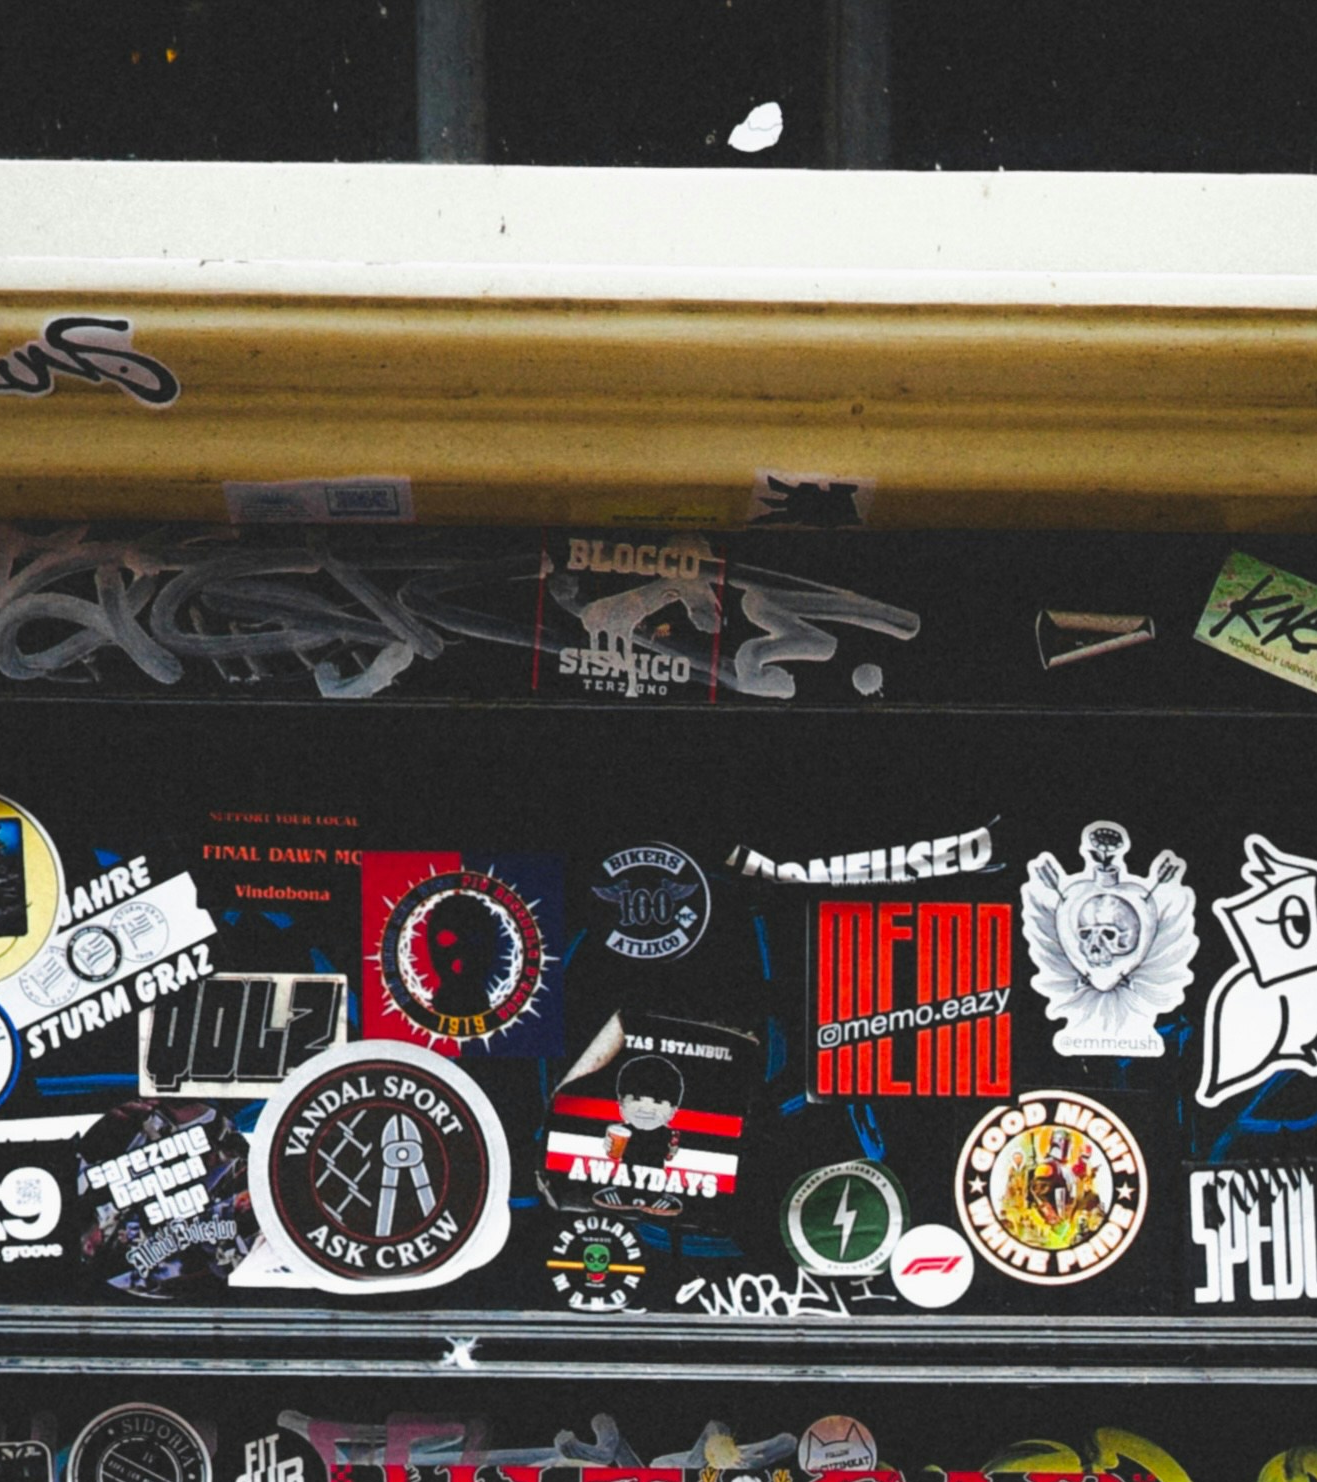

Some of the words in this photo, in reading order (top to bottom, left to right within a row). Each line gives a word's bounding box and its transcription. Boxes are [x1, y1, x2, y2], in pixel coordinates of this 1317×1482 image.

[567, 538, 700, 579] BLOCCO
[202, 844, 261, 865] FINAL
[267, 845, 328, 865] DAWN
[333, 847, 362, 865] MC
[605, 849, 686, 876] BIKERS
[234, 884, 330, 901] Vindobona
[24, 989, 133, 1060] STURM
[136, 943, 215, 1005] GRAZ
[438, 1014, 487, 1038] 1919
[660, 1038, 734, 1061] ISTANBUL
[283, 1075, 377, 1159] VANDAL
[383, 1074, 464, 1137] SPORT
[971, 1103, 1049, 1173] GOOD
[1056, 1098, 1136, 1177] NIGHT
[569, 1157, 719, 1199] AWAYDAYS
[1, 1241, 63, 1262] groove
[305, 1221, 368, 1268] ASK
[374, 1209, 463, 1270] CREW
[969, 1204, 1051, 1272] WHITE
[1056, 1203, 1136, 1274] PRIDE
